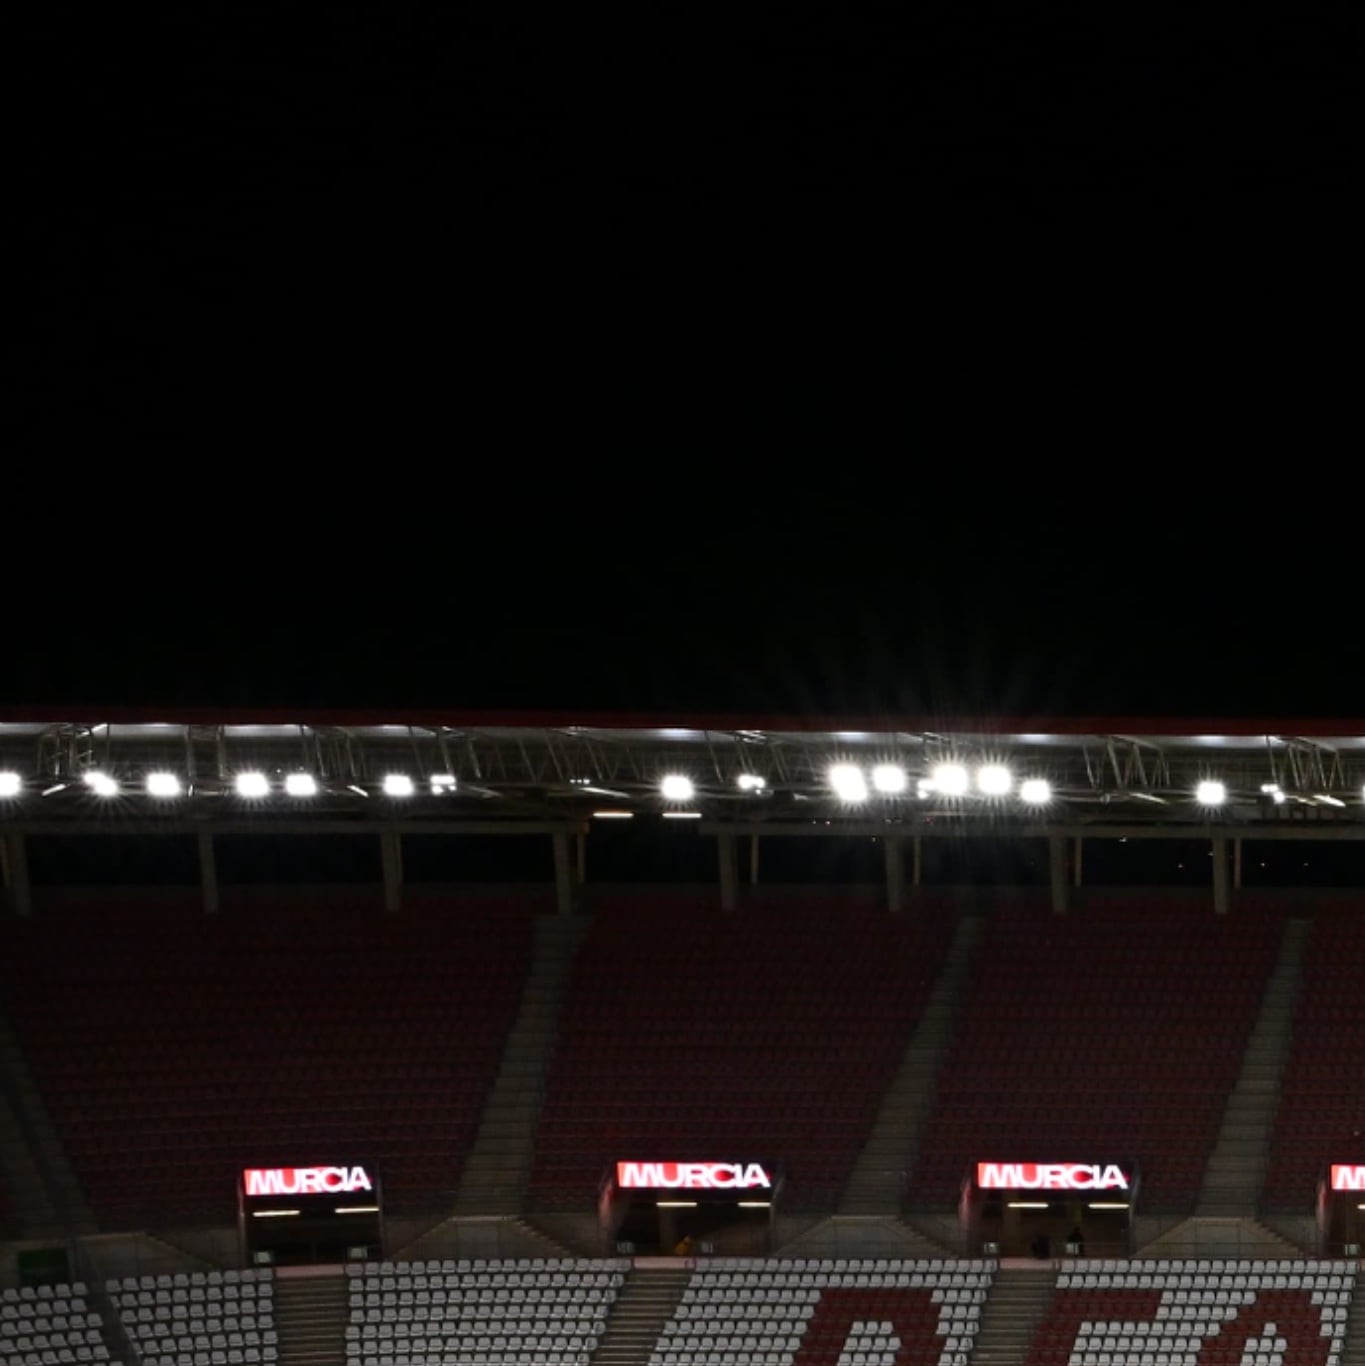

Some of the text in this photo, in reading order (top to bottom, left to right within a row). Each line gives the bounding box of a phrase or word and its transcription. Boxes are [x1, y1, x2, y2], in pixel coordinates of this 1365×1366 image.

[250, 1167, 371, 1195] MURCIA
[623, 1163, 770, 1187] MURCIA
[981, 1163, 1127, 1189] MURCIA
